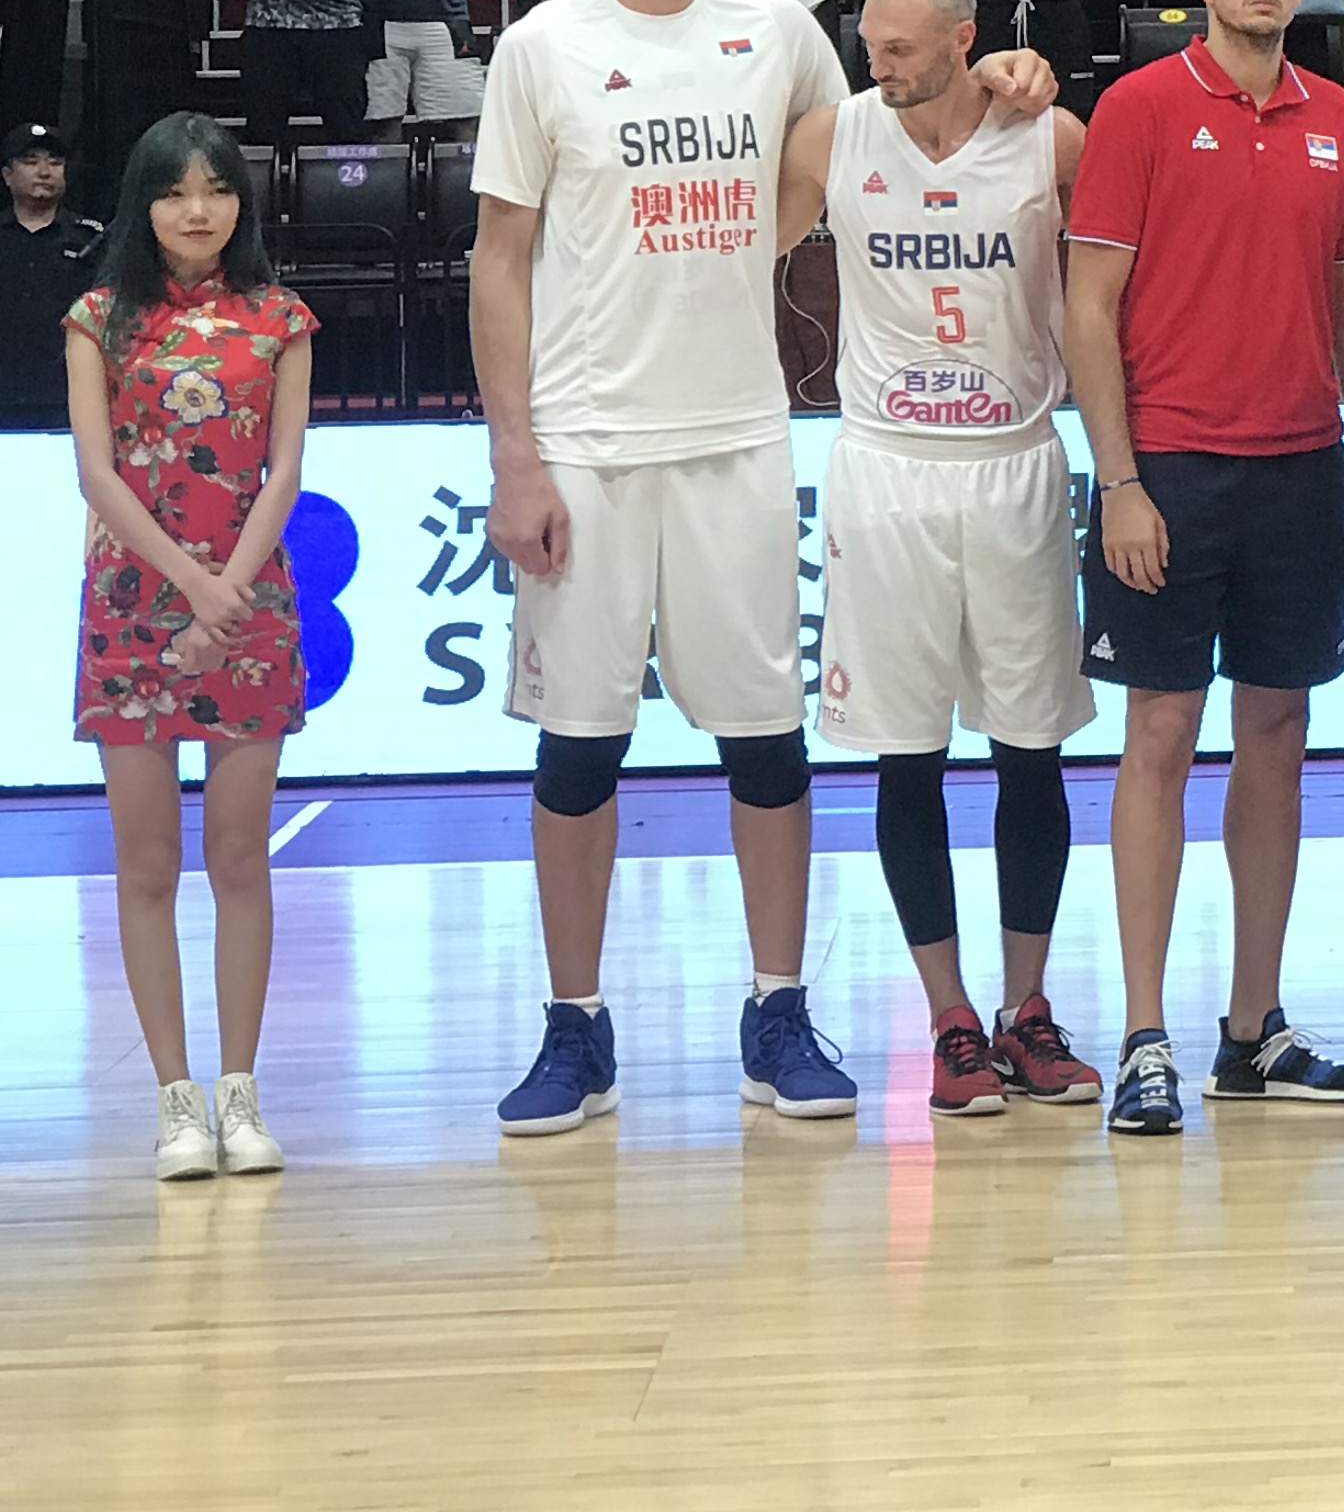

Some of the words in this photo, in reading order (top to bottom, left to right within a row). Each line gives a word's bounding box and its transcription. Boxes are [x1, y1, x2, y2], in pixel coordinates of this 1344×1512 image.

[621, 112, 760, 167] SRBIJA
[340, 165, 365, 181] 24
[631, 177, 757, 228] 澳洲虎
[635, 225, 757, 255] Austiger
[868, 231, 1016, 271] SRBIJA
[932, 285, 966, 344] 5
[903, 369, 985, 394] 百岁山
